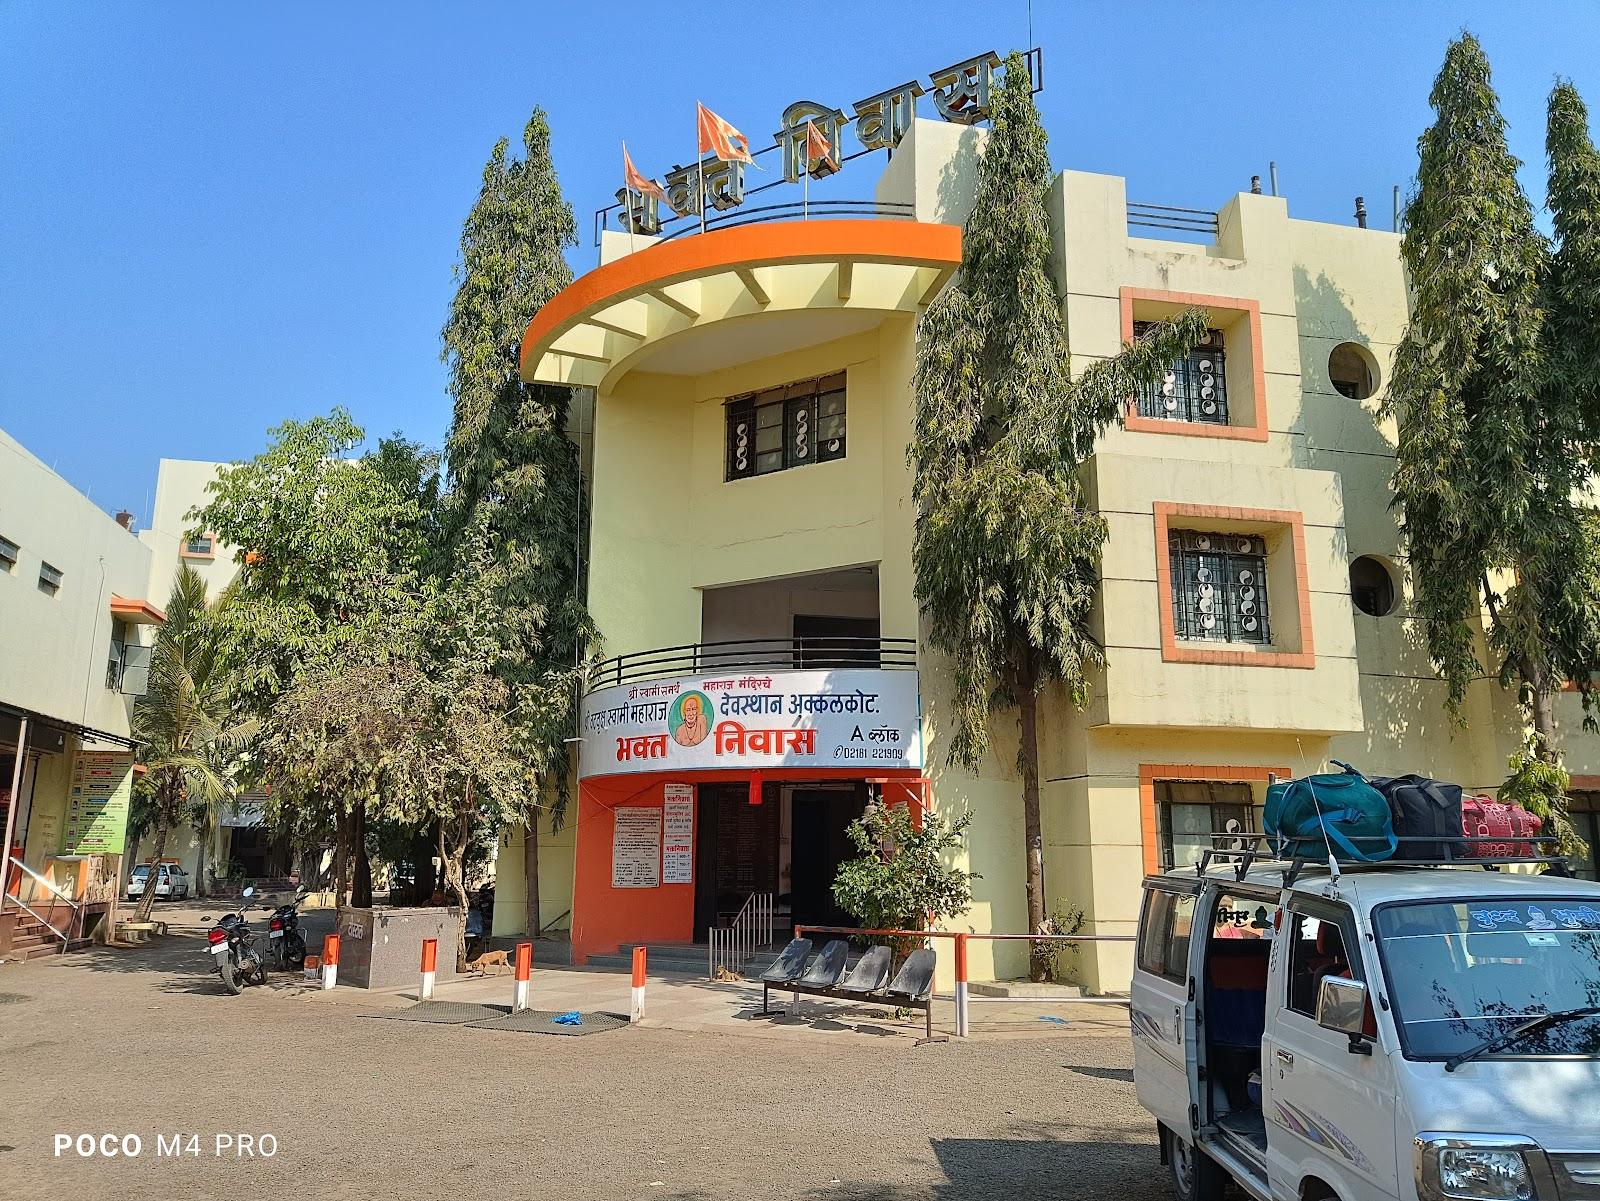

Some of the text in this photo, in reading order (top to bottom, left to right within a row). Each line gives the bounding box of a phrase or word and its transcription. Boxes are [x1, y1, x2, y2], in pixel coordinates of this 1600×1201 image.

[774, 51, 1003, 184] निवास
[628, 686, 638, 700] श्री
[703, 680, 735, 693] महाराज
[738, 676, 772, 691] मंदिरचे
[608, 702, 629, 726] स्वामी
[631, 701, 668, 724] महाराज
[720, 692, 784, 716] देवस्थान
[788, 689, 880, 715] अक्कलकोट.
[616, 720, 819, 762] भक्त निवास
[850, 723, 900, 744] A ब्लॉक
[844, 747, 903, 759] 02181 221909
